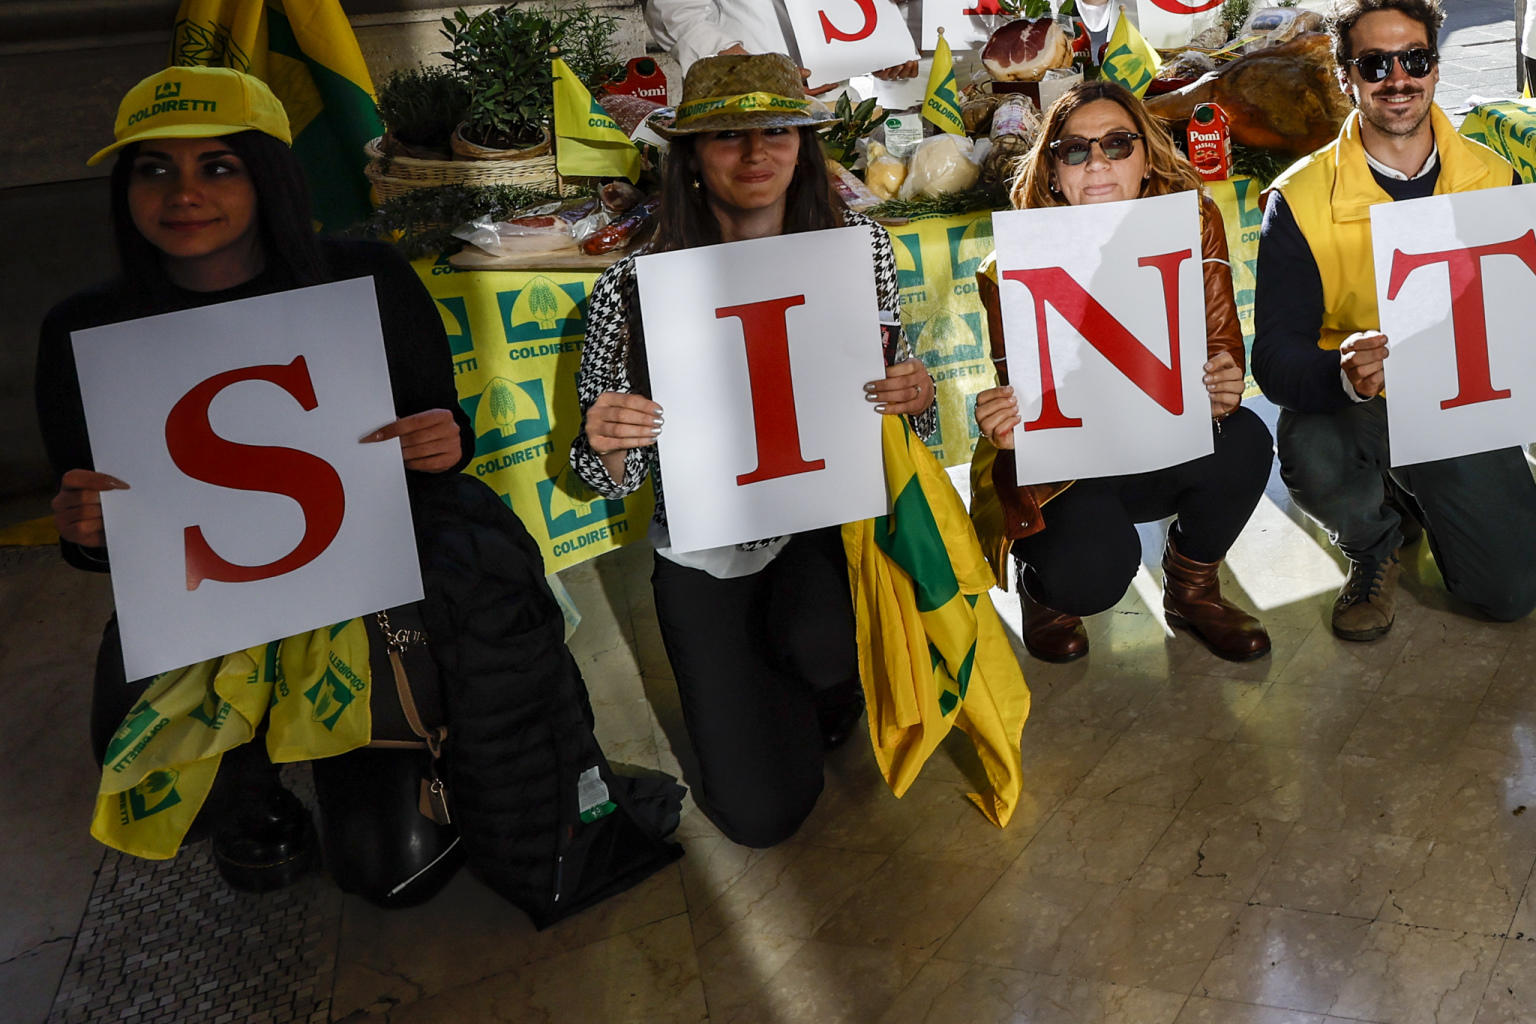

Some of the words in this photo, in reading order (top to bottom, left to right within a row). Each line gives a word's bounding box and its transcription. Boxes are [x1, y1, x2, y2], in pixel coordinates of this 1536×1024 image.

[128, 99, 217, 126] COLDIRETTI
[1189, 130, 1221, 142] Pomì
[476, 440, 555, 478] COLDIRETTI
[552, 519, 629, 557] COLDIRETTI
